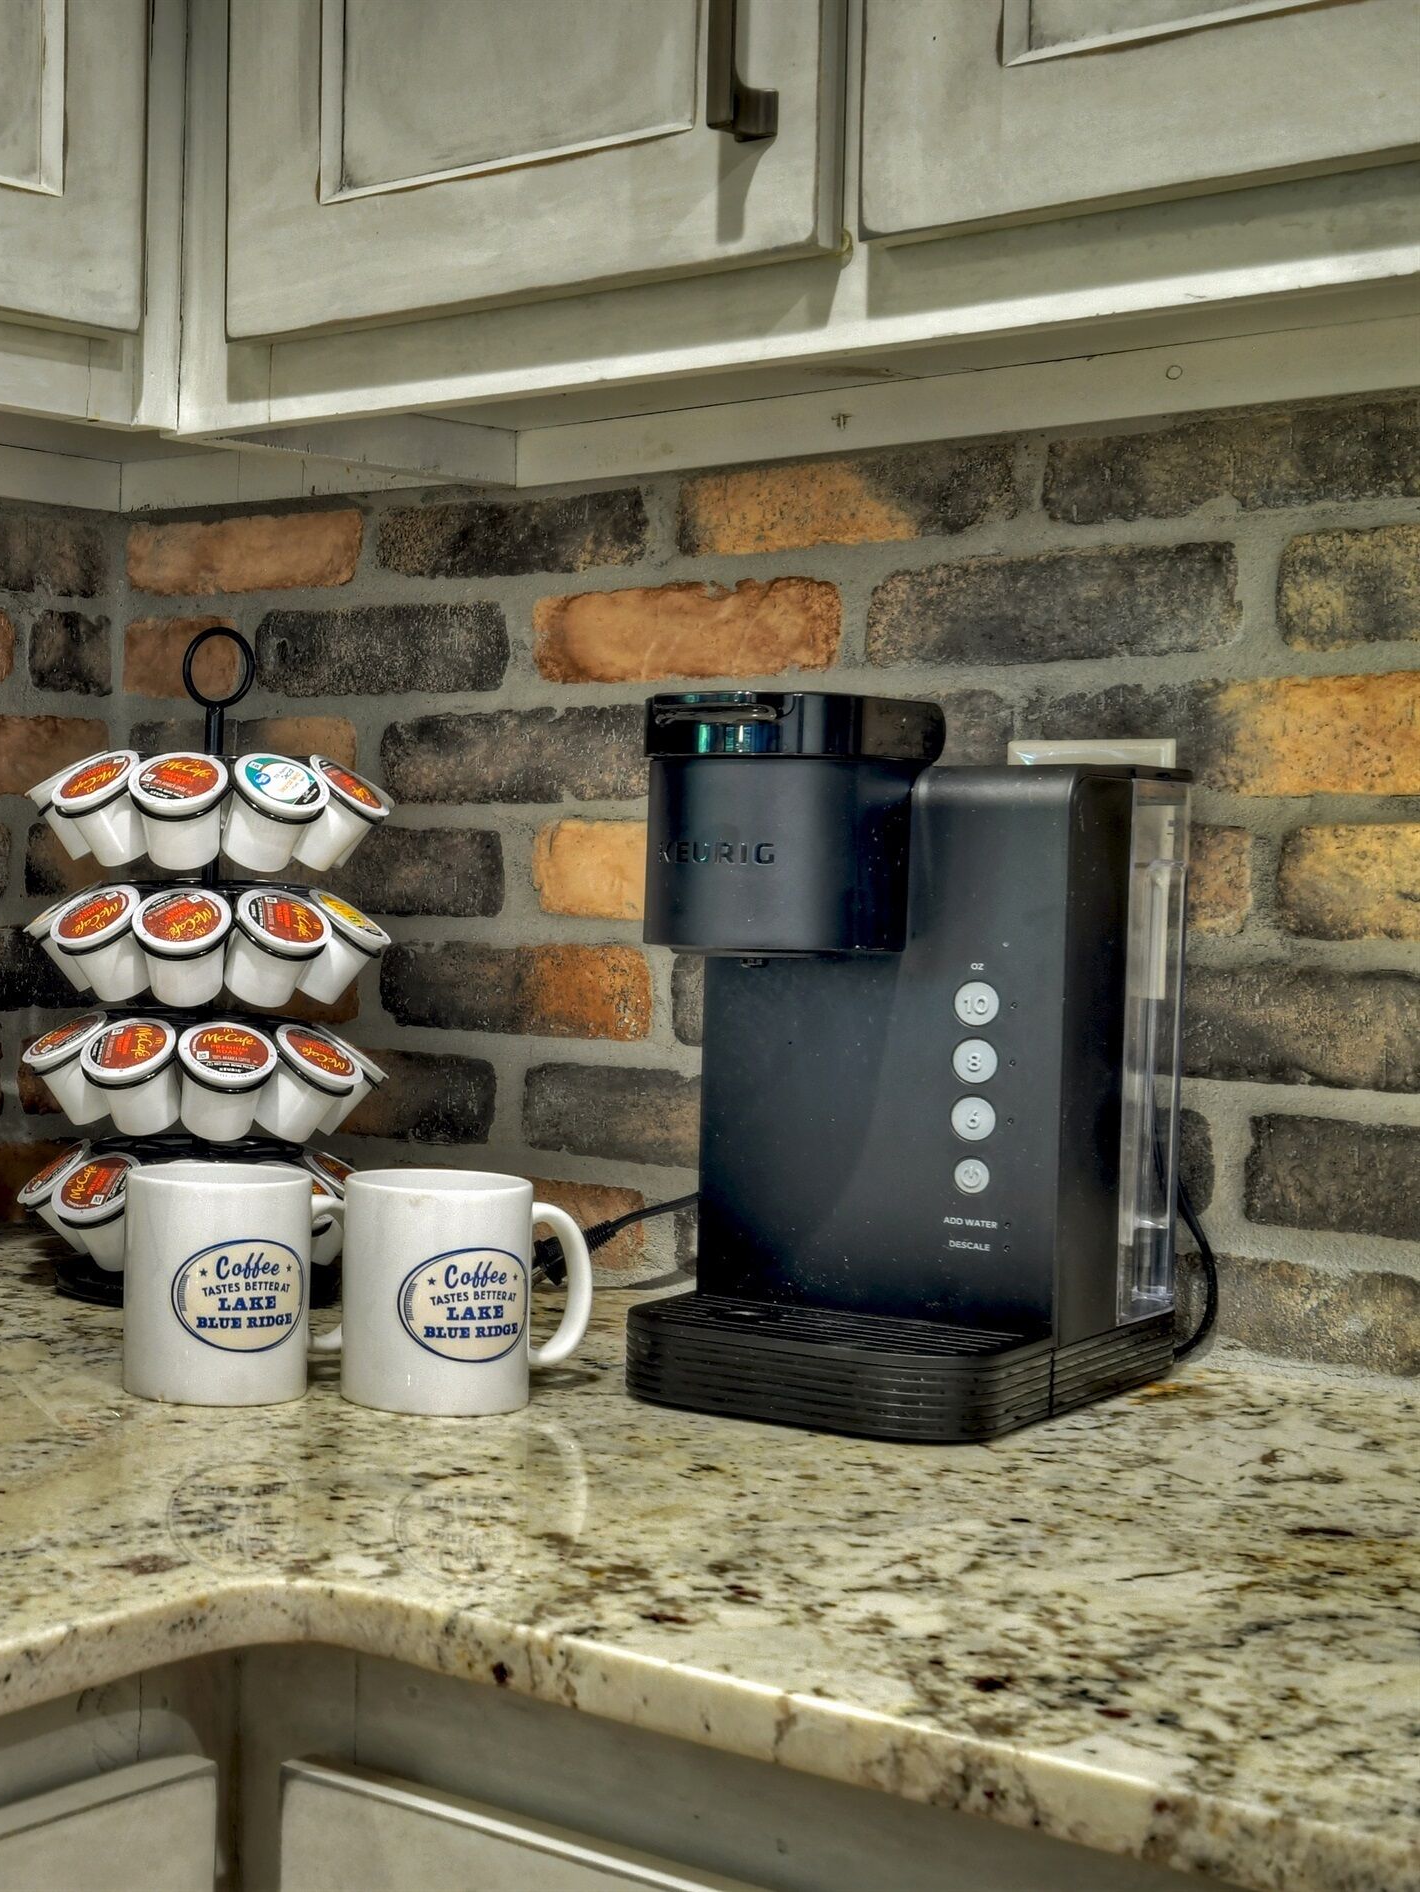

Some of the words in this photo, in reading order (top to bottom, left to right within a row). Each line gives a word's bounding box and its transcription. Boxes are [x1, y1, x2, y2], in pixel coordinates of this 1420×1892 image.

[659, 841, 777, 867] KEURIG
[964, 995, 989, 1016] 10
[966, 1051, 982, 1073] 8
[966, 1109, 981, 1130] 6
[943, 1216, 964, 1225] ADD
[965, 1218, 998, 1230] WATER
[949, 1239, 991, 1252] DESCALE
[215, 1252, 281, 1280] Coffee
[444, 1261, 508, 1289] Coffee
[202, 1282, 240, 1297] TASTES
[244, 1281, 280, 1292] BETTER
[280, 1283, 291, 1293] AT
[218, 1295, 277, 1311] LAKE
[430, 1292, 469, 1306] TASTES
[473, 1290, 508, 1301] BETTER
[508, 1292, 517, 1302] AT
[196, 1316, 242, 1329] BLUE
[246, 1312, 293, 1328] RIDGE
[446, 1305, 504, 1321] LAKE
[424, 1325, 470, 1338] BLUE
[475, 1322, 519, 1338] RIDGE
